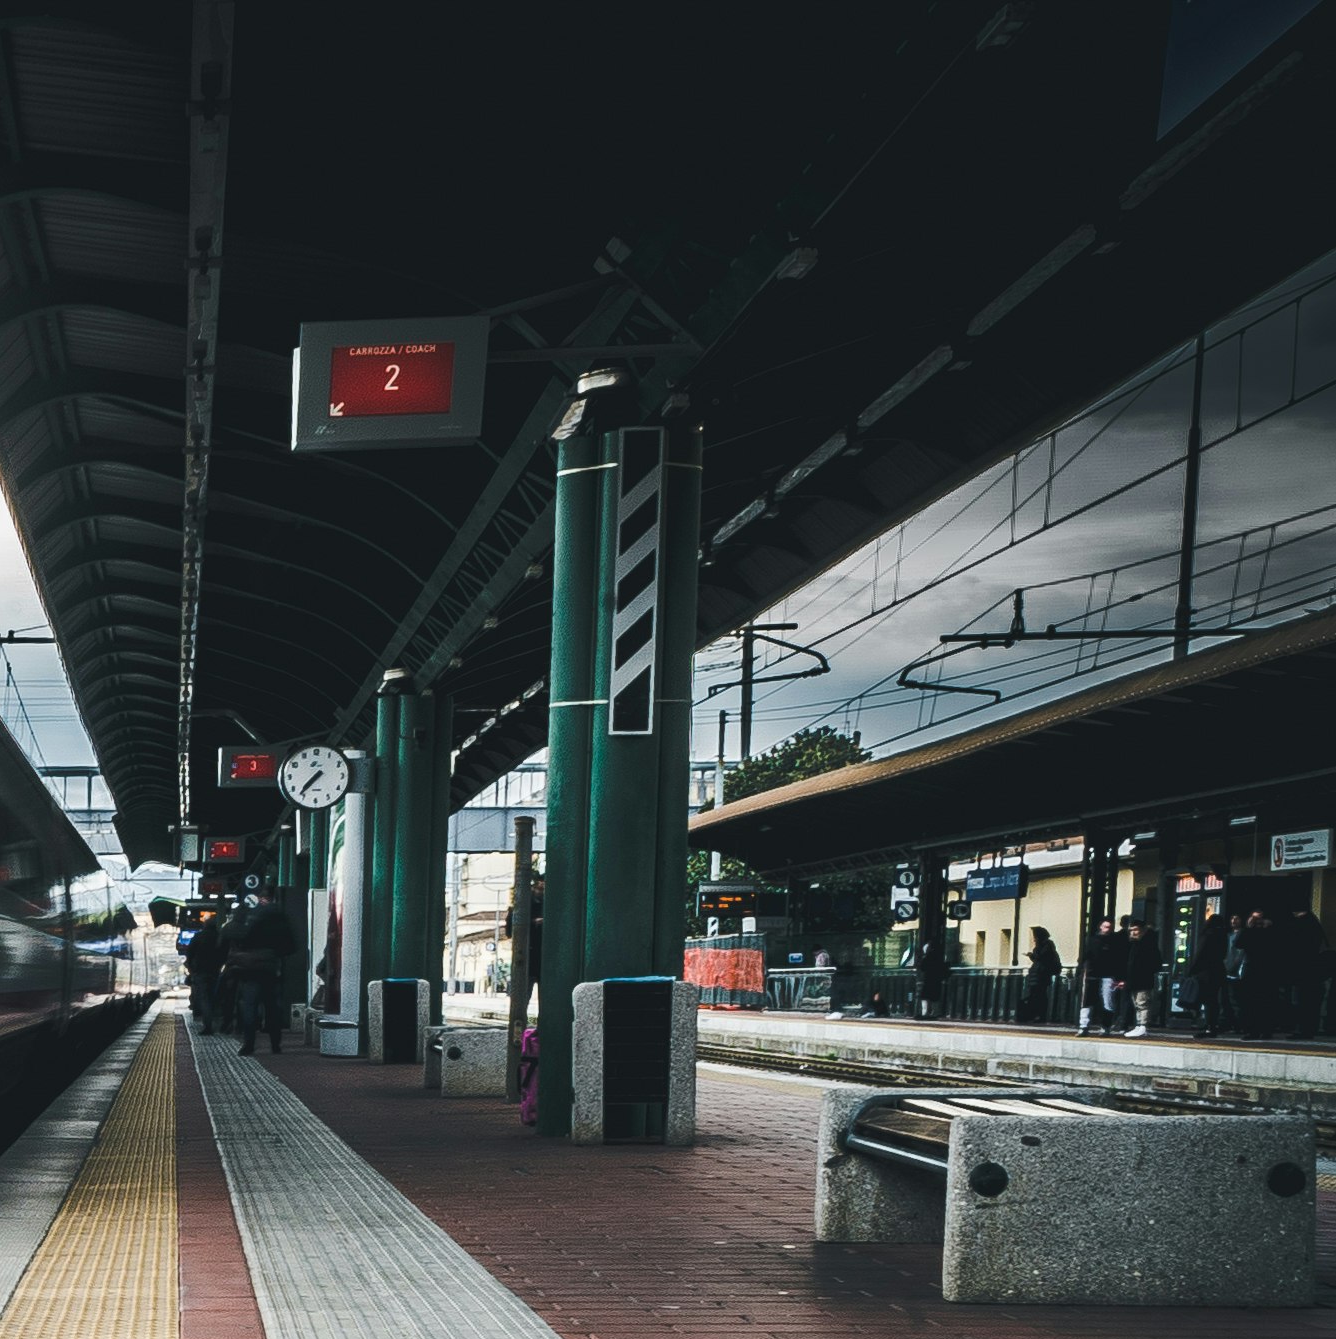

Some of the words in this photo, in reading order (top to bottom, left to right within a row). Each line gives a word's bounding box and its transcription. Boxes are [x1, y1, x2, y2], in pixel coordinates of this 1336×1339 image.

[349, 346, 396, 357] CARROZZA
[398, 345, 403, 355] /
[405, 344, 437, 355] COACH
[384, 363, 401, 391] 2
